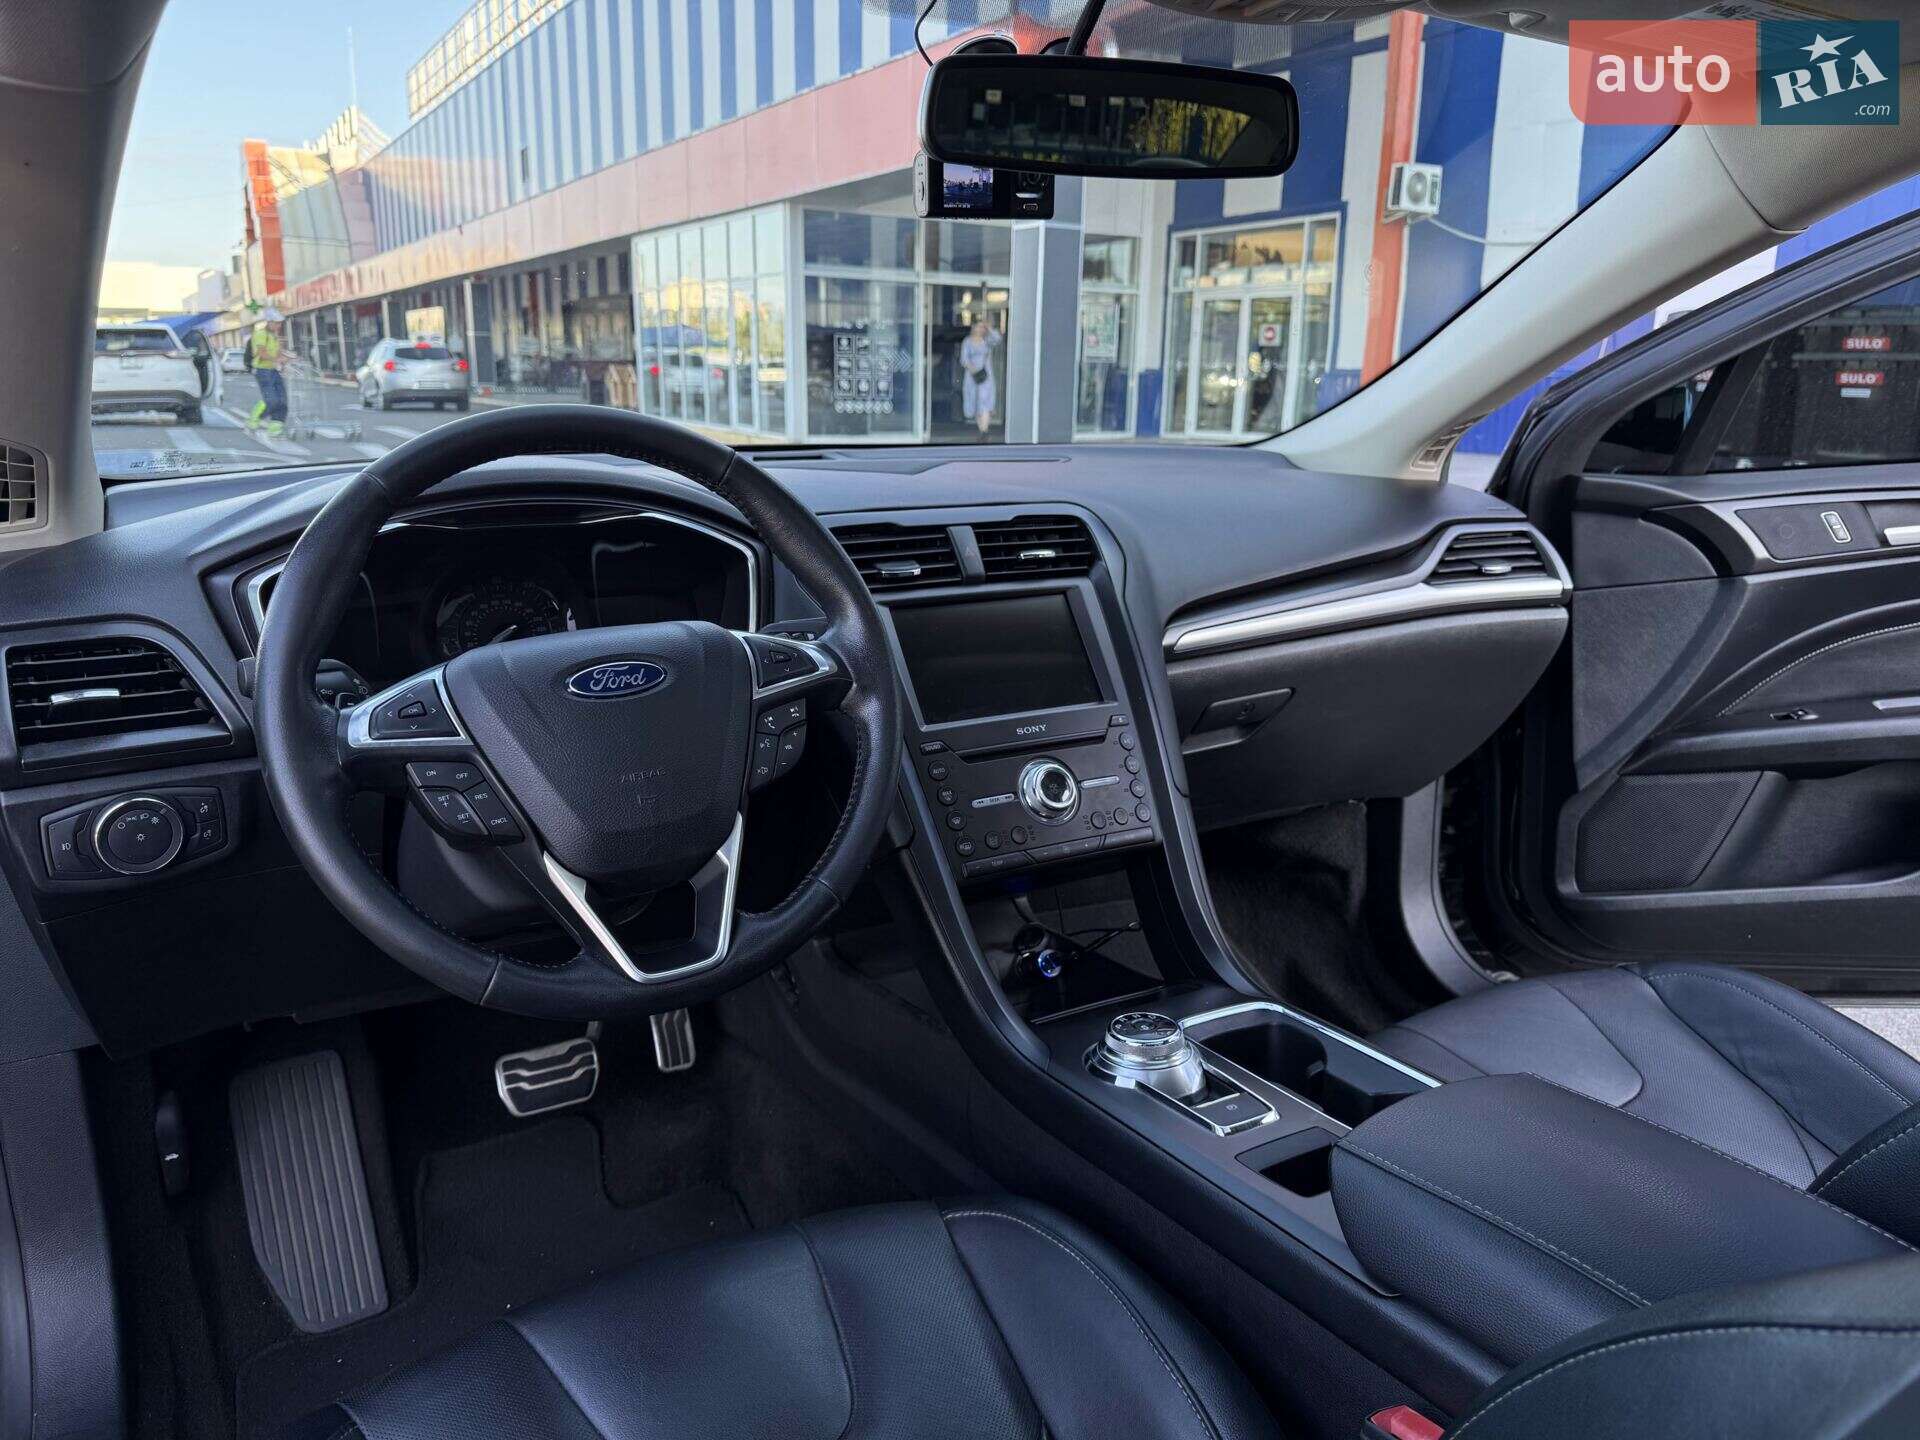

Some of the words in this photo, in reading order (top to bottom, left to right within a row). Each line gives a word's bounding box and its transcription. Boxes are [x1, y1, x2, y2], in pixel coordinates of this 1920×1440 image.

[1839, 372, 1877, 385] SULO
[589, 665, 647, 691] Ford
[1016, 724, 1047, 735] SONY
[426, 769, 437, 777] ON
[455, 772, 469, 780] OFF
[437, 794, 450, 802] SET
[474, 792, 488, 800] RES
[456, 812, 470, 821] SET
[490, 817, 508, 826] CNCL
